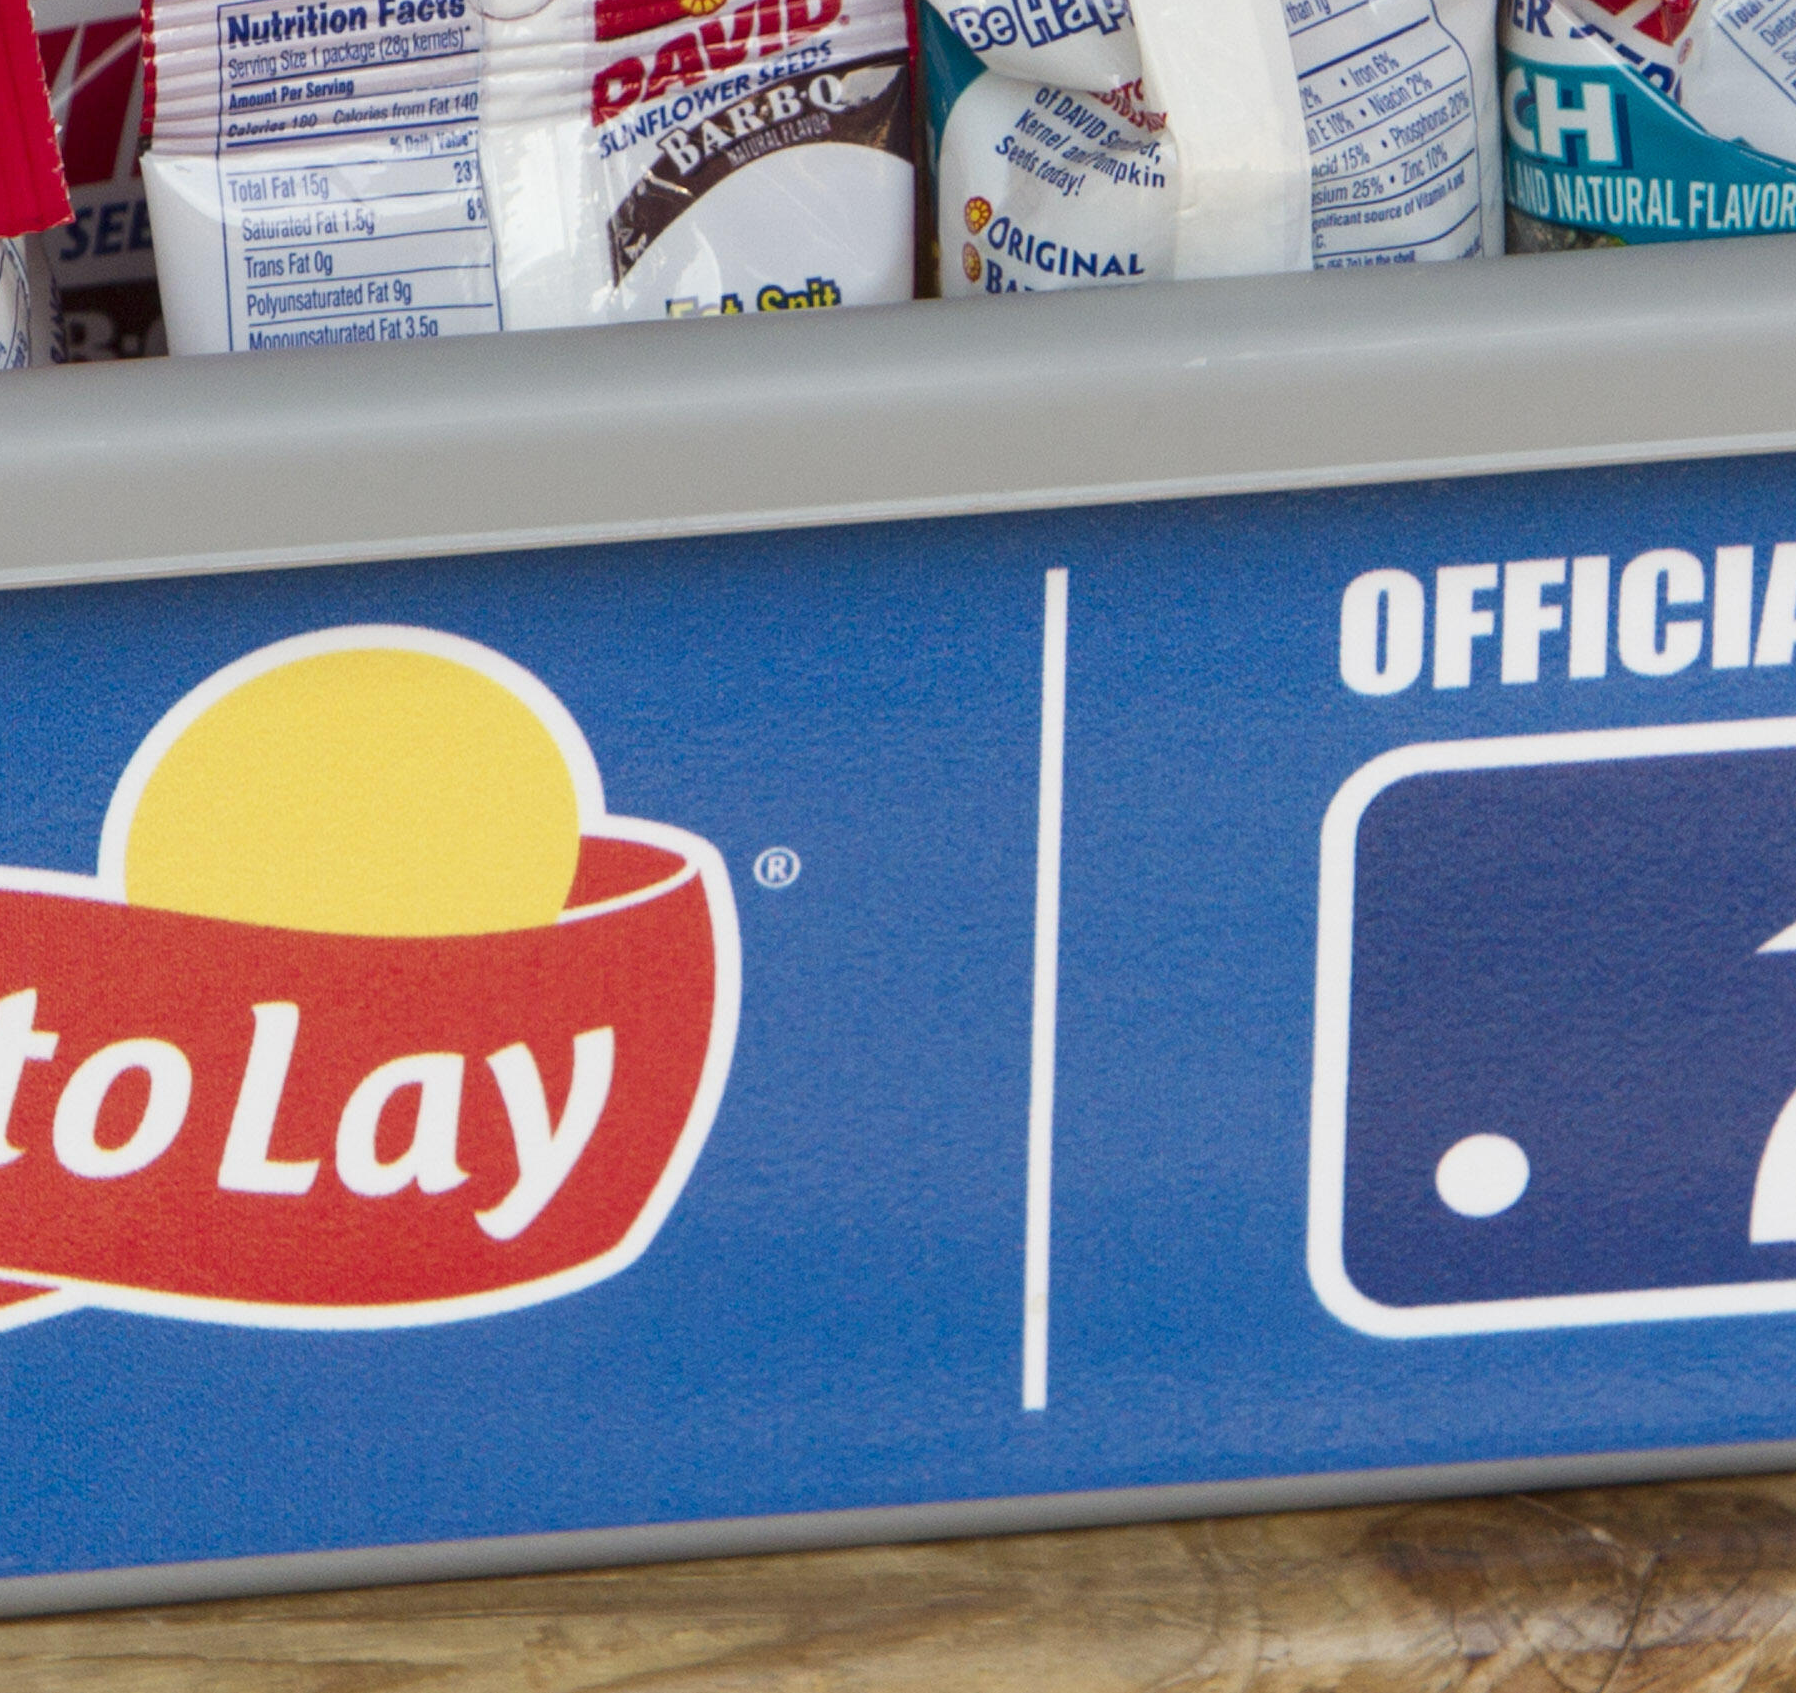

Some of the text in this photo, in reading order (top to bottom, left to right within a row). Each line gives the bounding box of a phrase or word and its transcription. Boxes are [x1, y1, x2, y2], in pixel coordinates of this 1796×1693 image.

[226, 3, 368, 48] Nutrition
[948, 5, 1018, 53] Be
[1286, 0, 1310, 25] than
[228, 57, 277, 80] Serving
[280, 50, 307, 70] Size
[322, 39, 376, 68] package
[1348, 51, 1400, 88] Iron 6%
[228, 78, 355, 110] Amount Per Serving
[333, 91, 478, 125] Calories from Fat 140
[600, 39, 832, 159] SUNFLOWER SEEDS
[1034, 87, 1061, 109] of
[1055, 96, 1107, 140] DAVID
[1368, 71, 1433, 117] Niacin 2%
[226, 119, 286, 137] Calories
[1015, 108, 1071, 150] Kernel
[1327, 111, 1355, 135] 10%
[1388, 105, 1450, 149] Phosphorus
[994, 134, 1086, 197] Seeds today!
[1341, 142, 1371, 170] 15%
[1401, 142, 1449, 185] Zinc 10%
[228, 173, 330, 204] Total Fat 15g
[1352, 175, 1384, 199] 25%
[1554, 172, 1681, 228] NATURAL
[242, 208, 375, 242] Saturated Fat 1.5g
[1363, 205, 1403, 224] source
[244, 249, 333, 279] Trans Fat 0g
[987, 216, 1146, 278] ORIGINAL
[246, 278, 412, 319] Polyunsaturated Fat 9g
[248, 321, 376, 350] Monounsaturated
[379, 316, 401, 339] Fat
